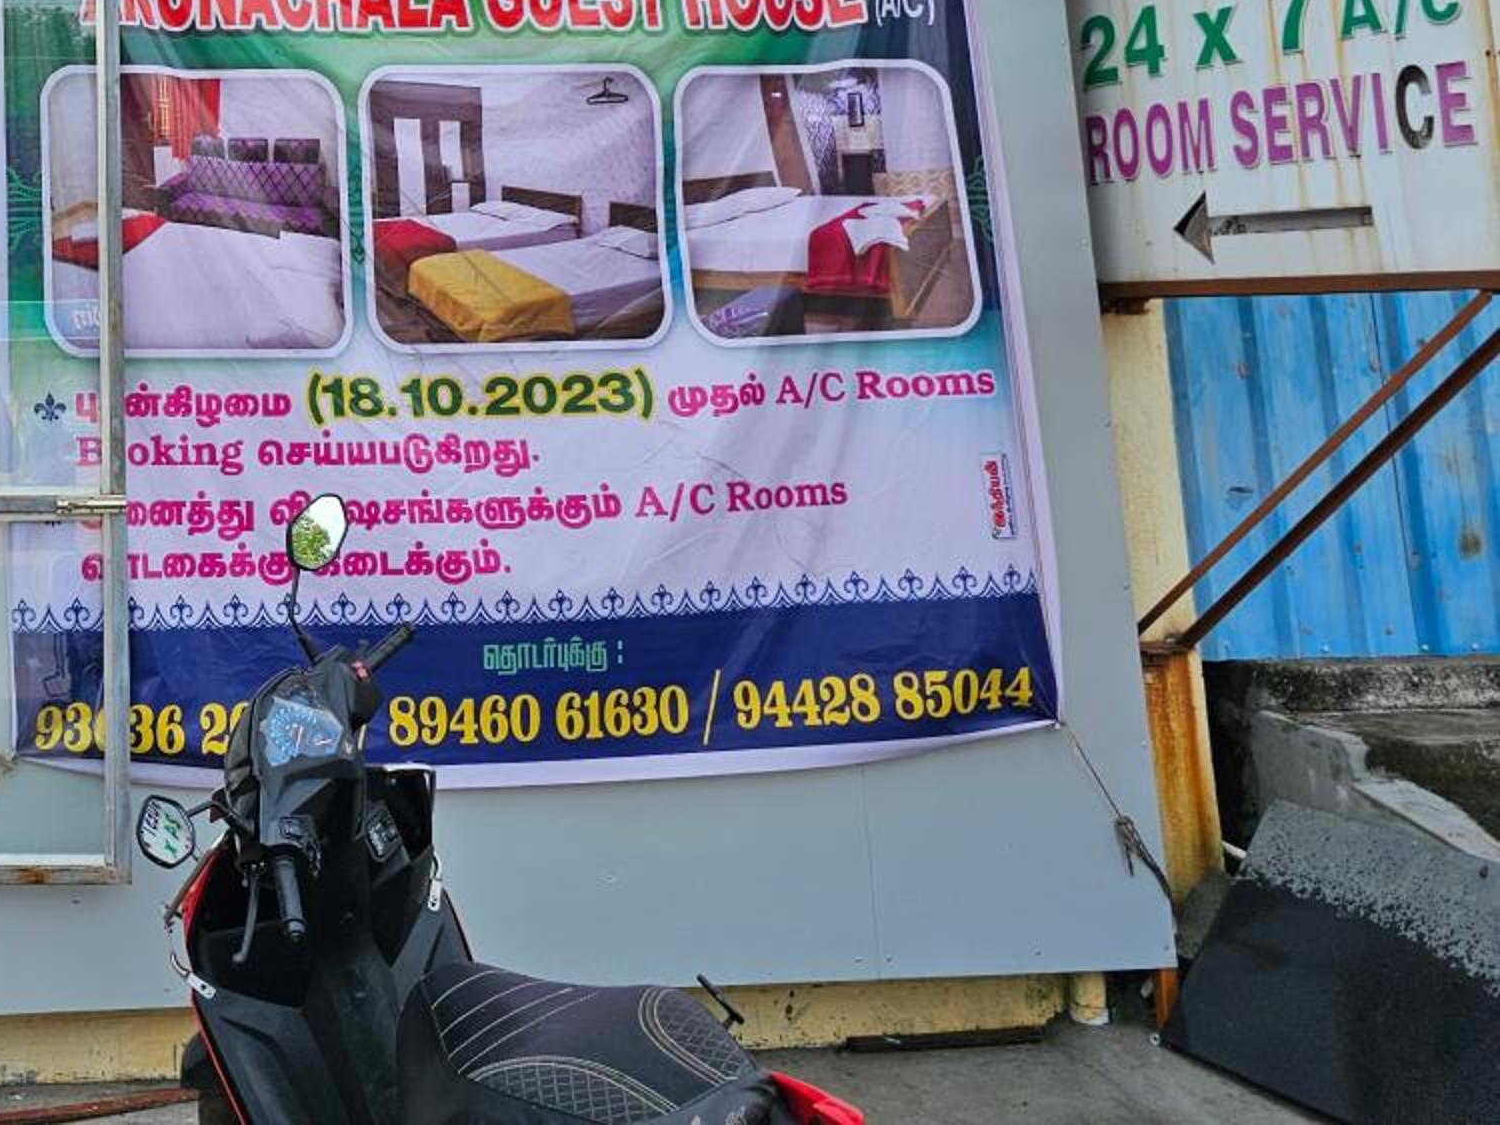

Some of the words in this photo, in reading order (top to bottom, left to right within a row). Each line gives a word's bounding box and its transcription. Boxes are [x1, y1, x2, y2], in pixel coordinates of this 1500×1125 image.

[1080, 3, 1165, 90] 24
[1085, 96, 1215, 185] ROOM
[1229, 60, 1477, 169] SERVICE
[75, 383, 291, 427] புன்கிழமை
[308, 368, 653, 426] (18.10.2023)
[667, 373, 766, 417] முதல்
[775, 373, 846, 410] A/C
[856, 368, 996, 400] Rooms
[75, 434, 244, 476] Boking
[83, 490, 255, 540] னைத்து
[635, 483, 715, 522] A/C
[727, 480, 849, 512] Rooms
[35, 701, 185, 756] 9336
[388, 691, 541, 746] 89460
[555, 685, 689, 741] 61630
[732, 673, 881, 728] 94428
[895, 666, 1034, 721] 85044
